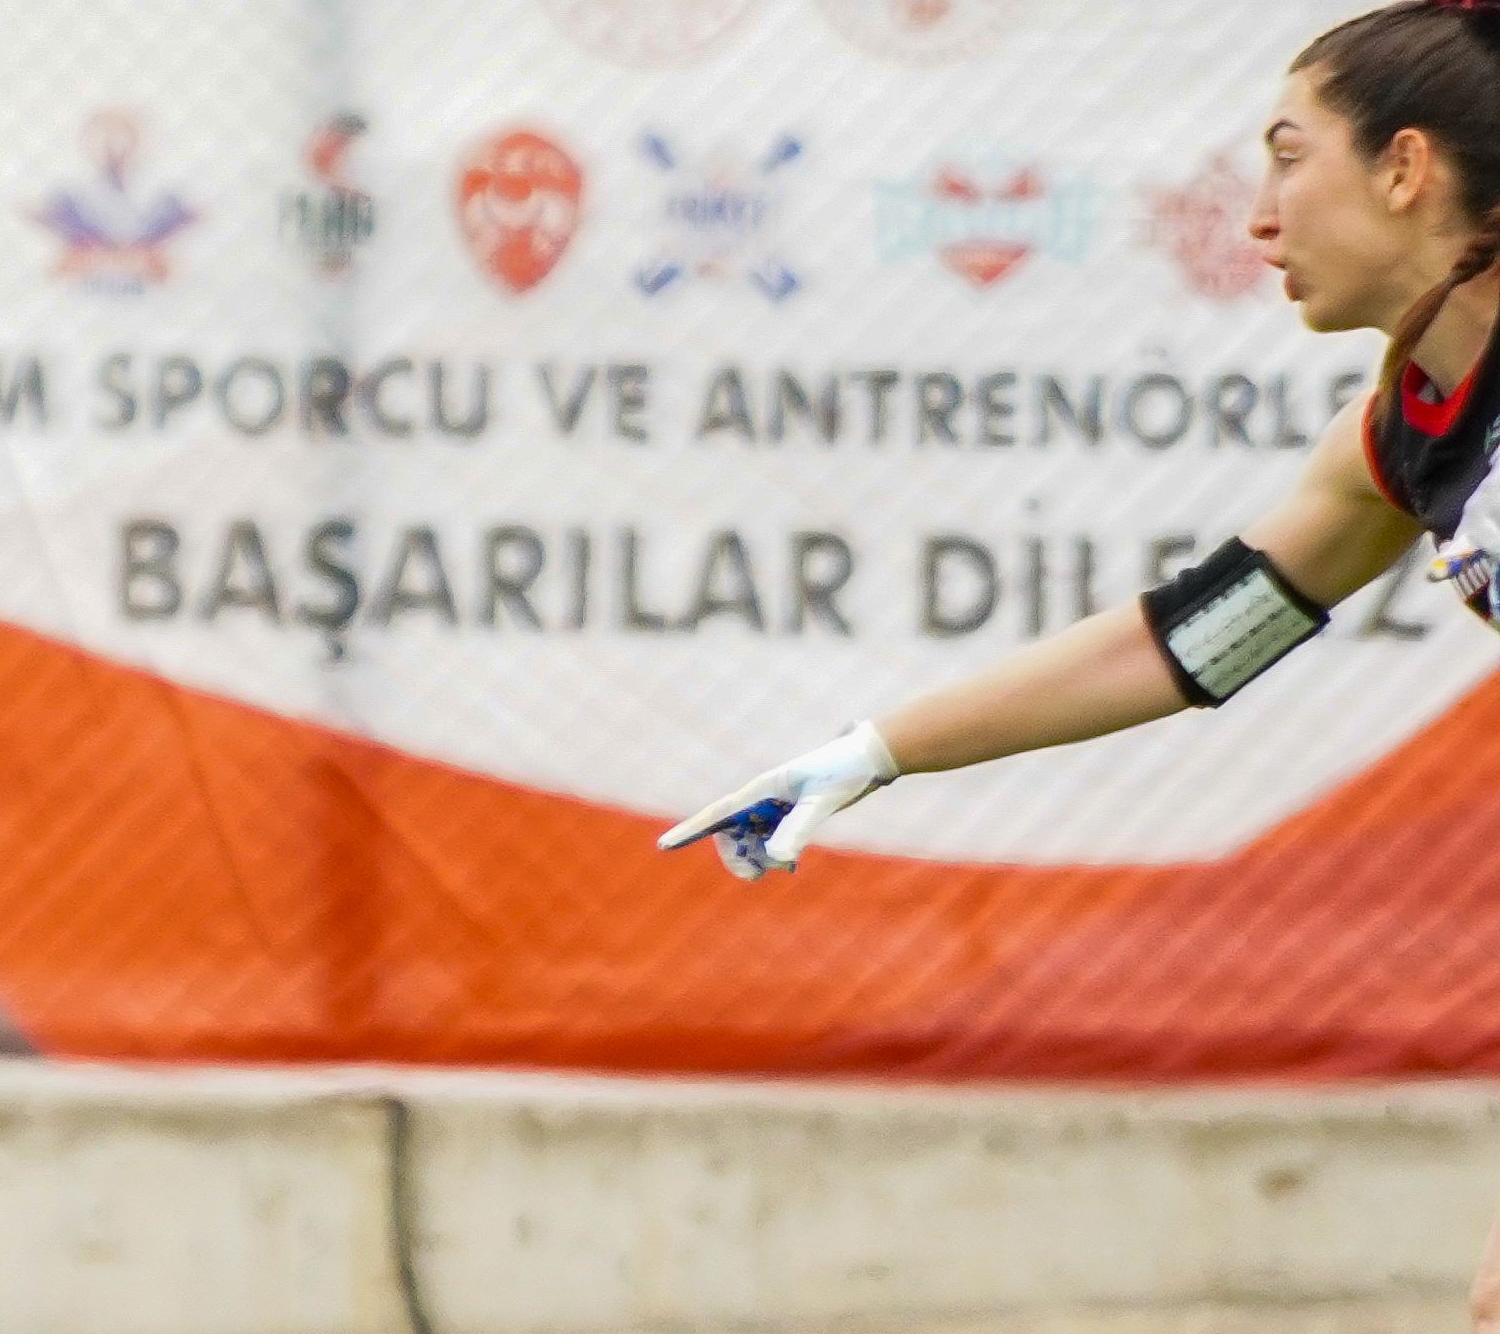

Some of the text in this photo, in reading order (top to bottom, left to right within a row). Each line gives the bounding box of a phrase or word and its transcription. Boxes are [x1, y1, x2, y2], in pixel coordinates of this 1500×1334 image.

[96, 352, 495, 438] SPORCU
[533, 362, 652, 444] VE
[118, 517, 857, 662] BAŞARILAR
